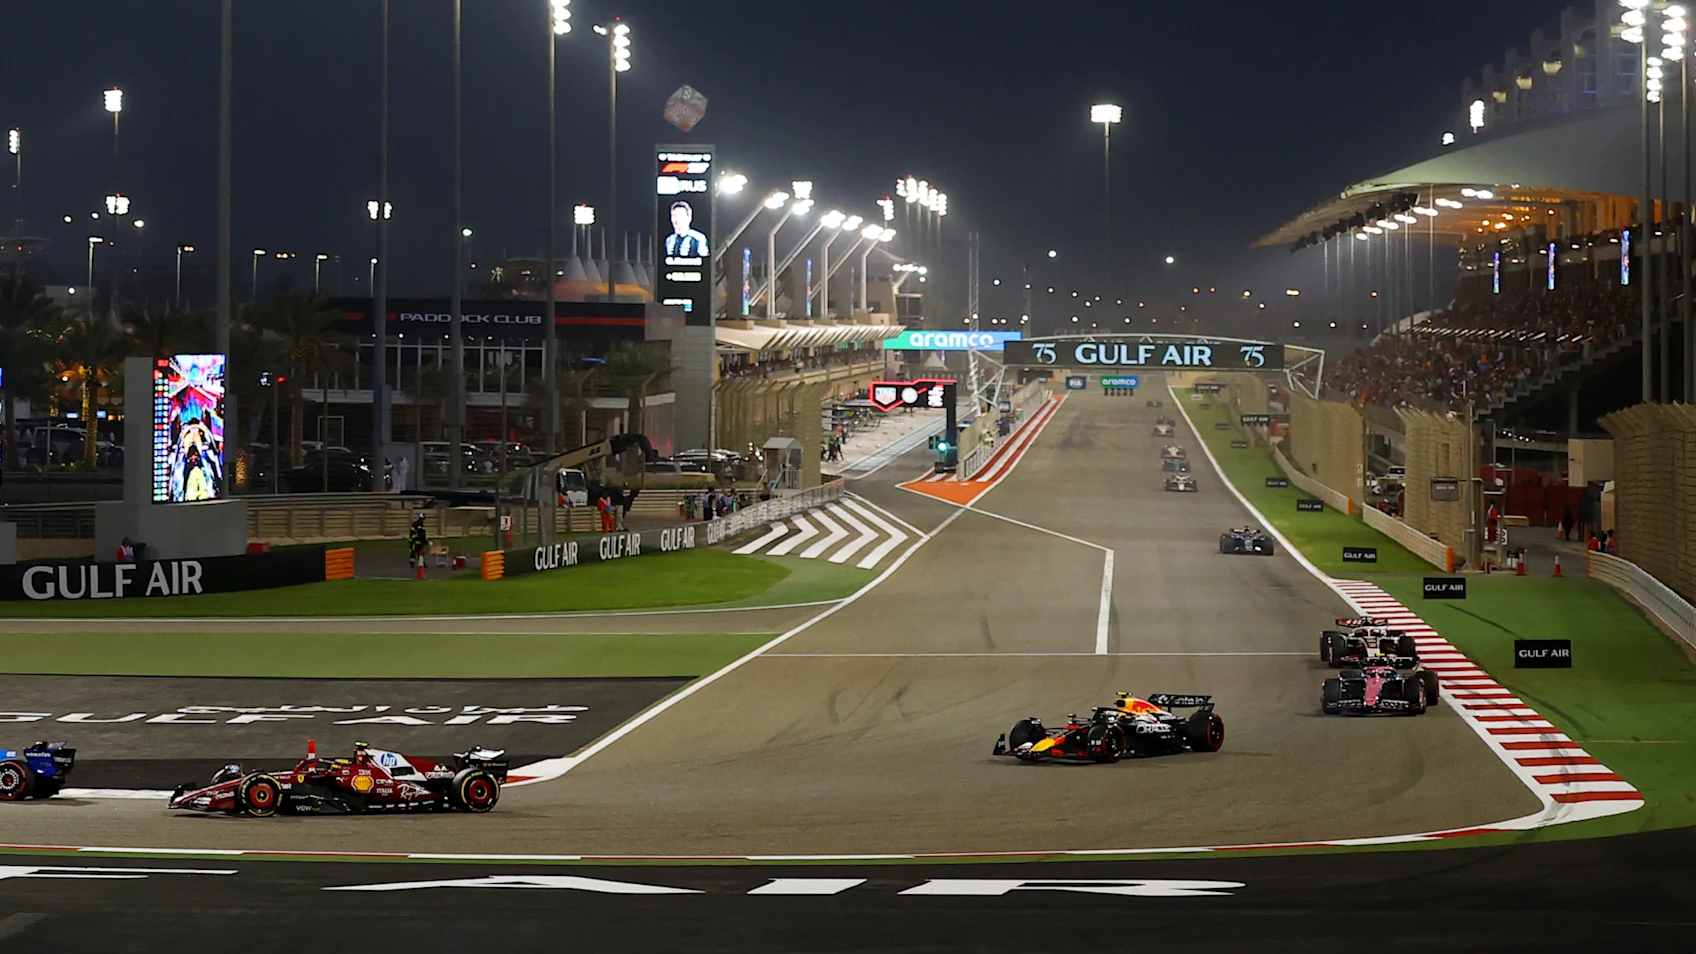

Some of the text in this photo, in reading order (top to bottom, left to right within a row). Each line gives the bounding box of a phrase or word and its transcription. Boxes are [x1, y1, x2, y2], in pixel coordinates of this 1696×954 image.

[493, 314, 542, 324] CLUB
[909, 332, 994, 348] aramco
[1032, 343, 1265, 367] 75 GULF AIR 75
[599, 533, 641, 560] GULF AIR
[660, 526, 695, 552] GULF AIR
[534, 541, 579, 571] GULF AIR
[21, 560, 204, 600] GULF AIR
[1518, 649, 1570, 658] GULF AIR
[333, 714, 577, 725] AIR
[1136, 724, 1171, 734] ORACLE
